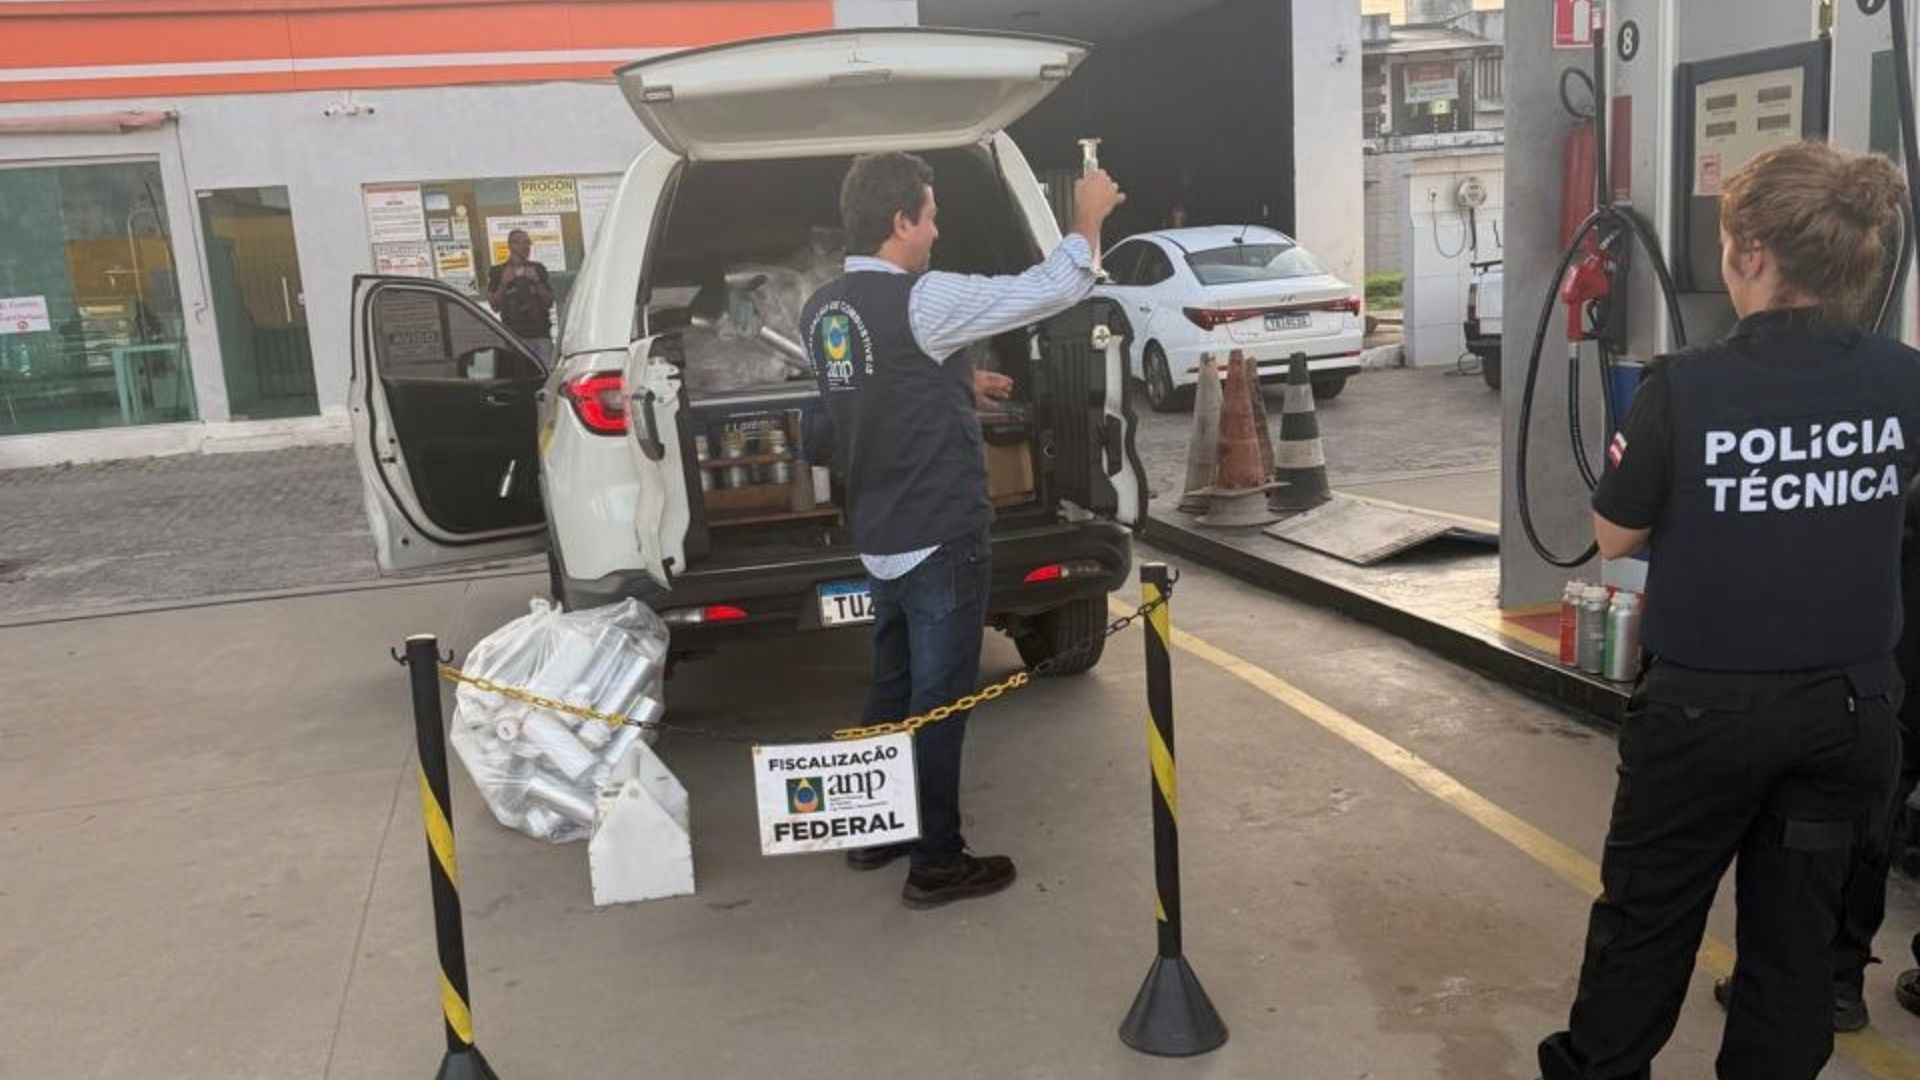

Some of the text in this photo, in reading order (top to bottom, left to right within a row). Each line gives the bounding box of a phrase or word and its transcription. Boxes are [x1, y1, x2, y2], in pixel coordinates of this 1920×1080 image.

[1622, 26, 1633, 56] 8
[521, 180, 573, 192] PROCON
[1705, 464, 1899, 512] TÉCNICA
[768, 745, 898, 772] FISCALIZAÇÃO
[827, 768, 886, 800] anp
[774, 811, 905, 842] FEDERAL
